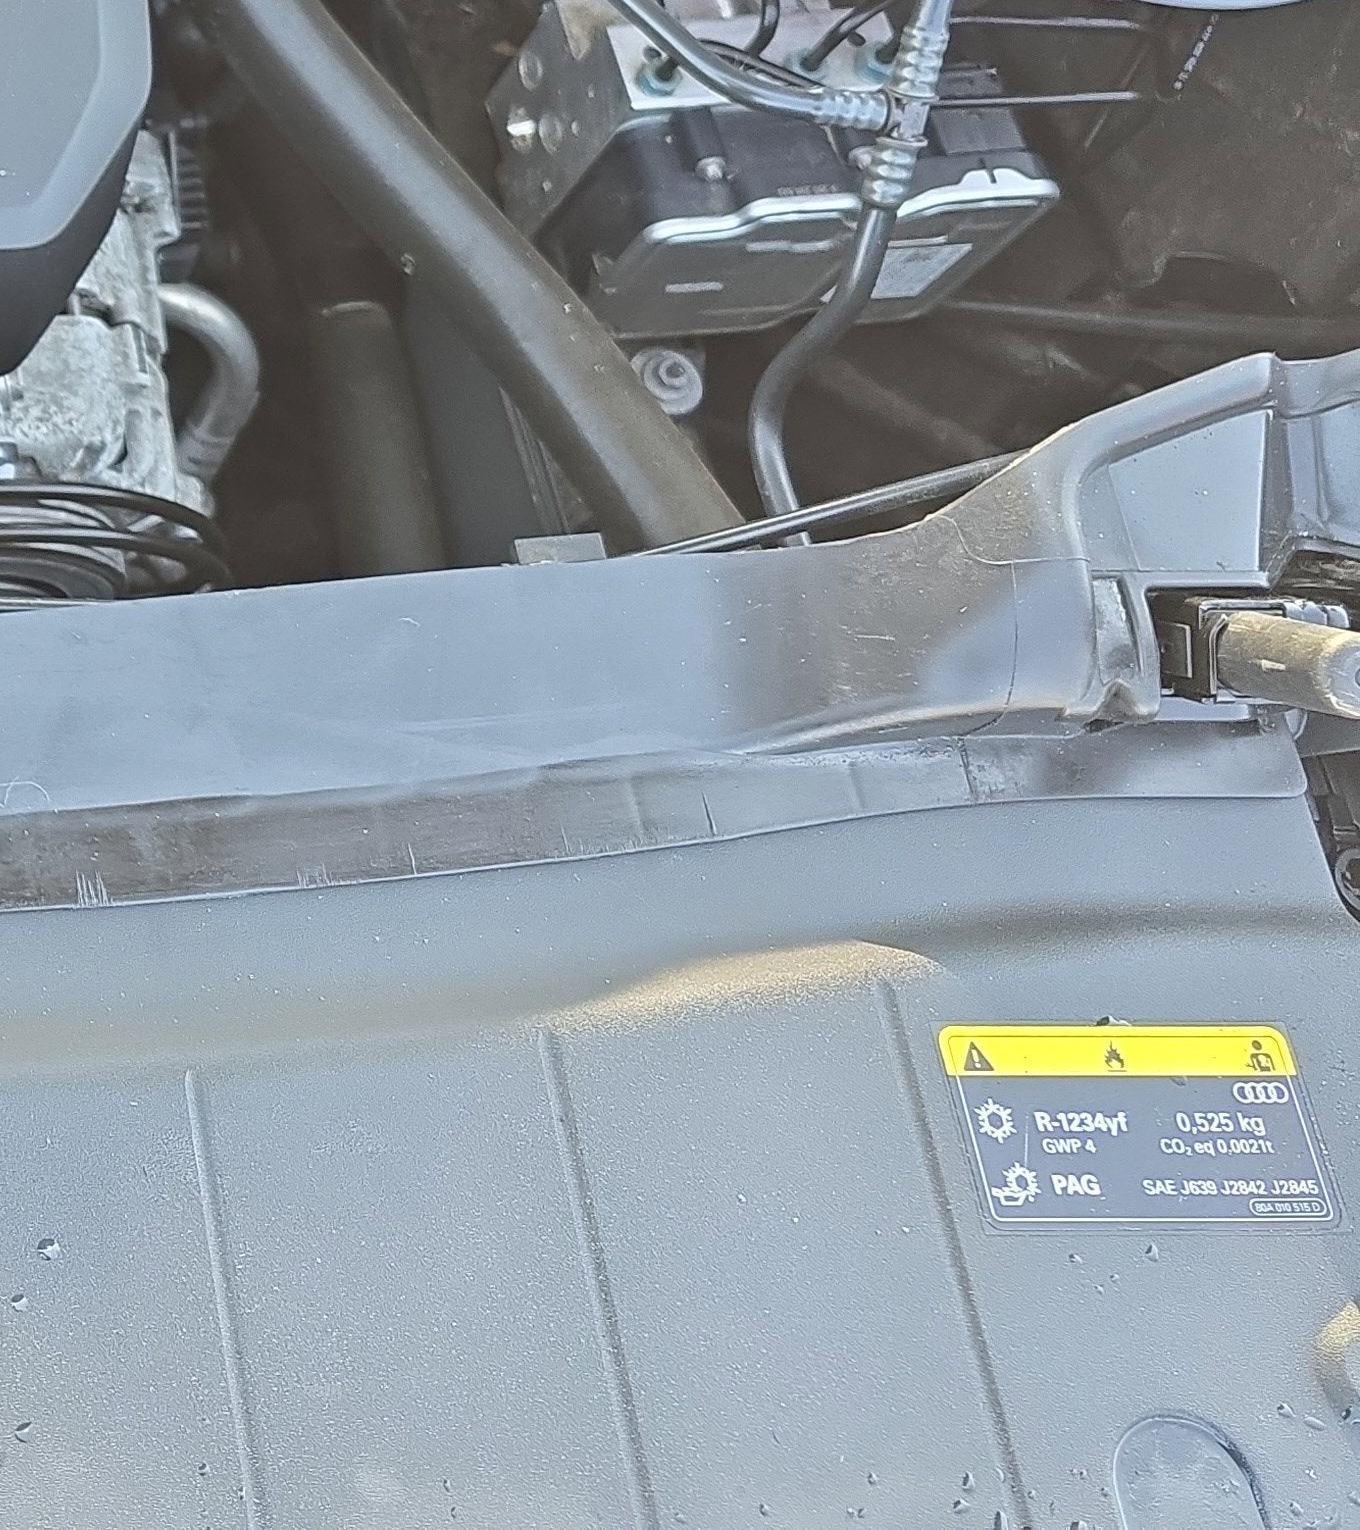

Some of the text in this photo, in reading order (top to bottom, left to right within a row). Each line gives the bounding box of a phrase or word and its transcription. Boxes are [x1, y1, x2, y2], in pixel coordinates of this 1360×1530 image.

[1036, 1111, 1128, 1137] R-1234yf
[1175, 1111, 1267, 1137] 0,525 kg
[1041, 1138, 1082, 1154] GWP
[1193, 1139, 1216, 1157] eq
[1050, 1174, 1102, 1196] PAG
[1142, 1179, 1319, 1196] SAE J639 J2842 J2845
[1274, 1202, 1292, 1213] 010
[1291, 1202, 1312, 1212] 515
